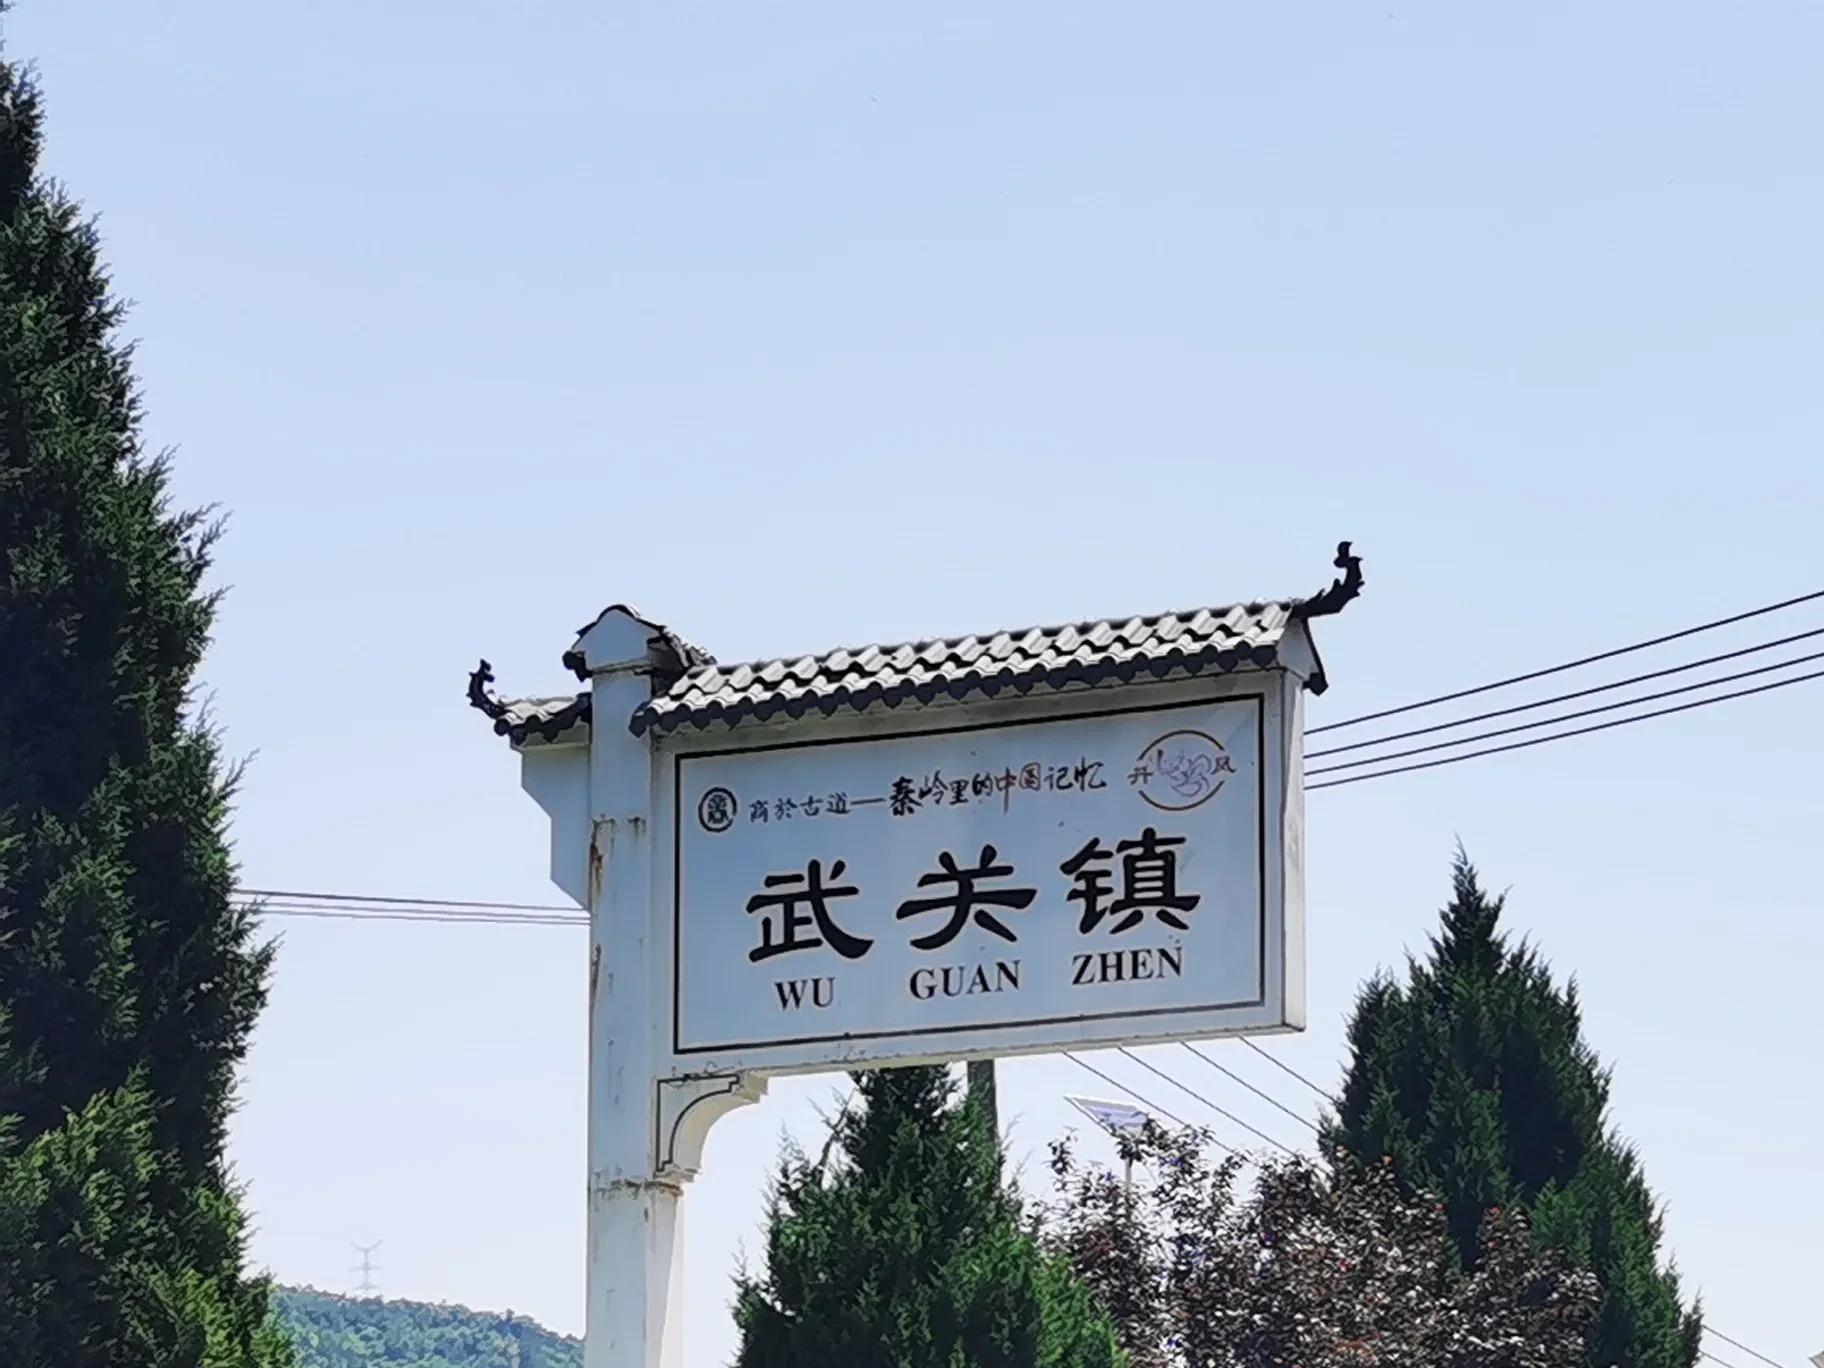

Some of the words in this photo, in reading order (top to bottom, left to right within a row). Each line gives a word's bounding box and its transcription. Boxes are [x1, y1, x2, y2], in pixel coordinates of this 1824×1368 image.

[746, 828, 1201, 963] 武关镇
[776, 977, 837, 1011] WU
[909, 961, 1022, 1001] GUAN
[1071, 945, 1184, 986] ZHEN
